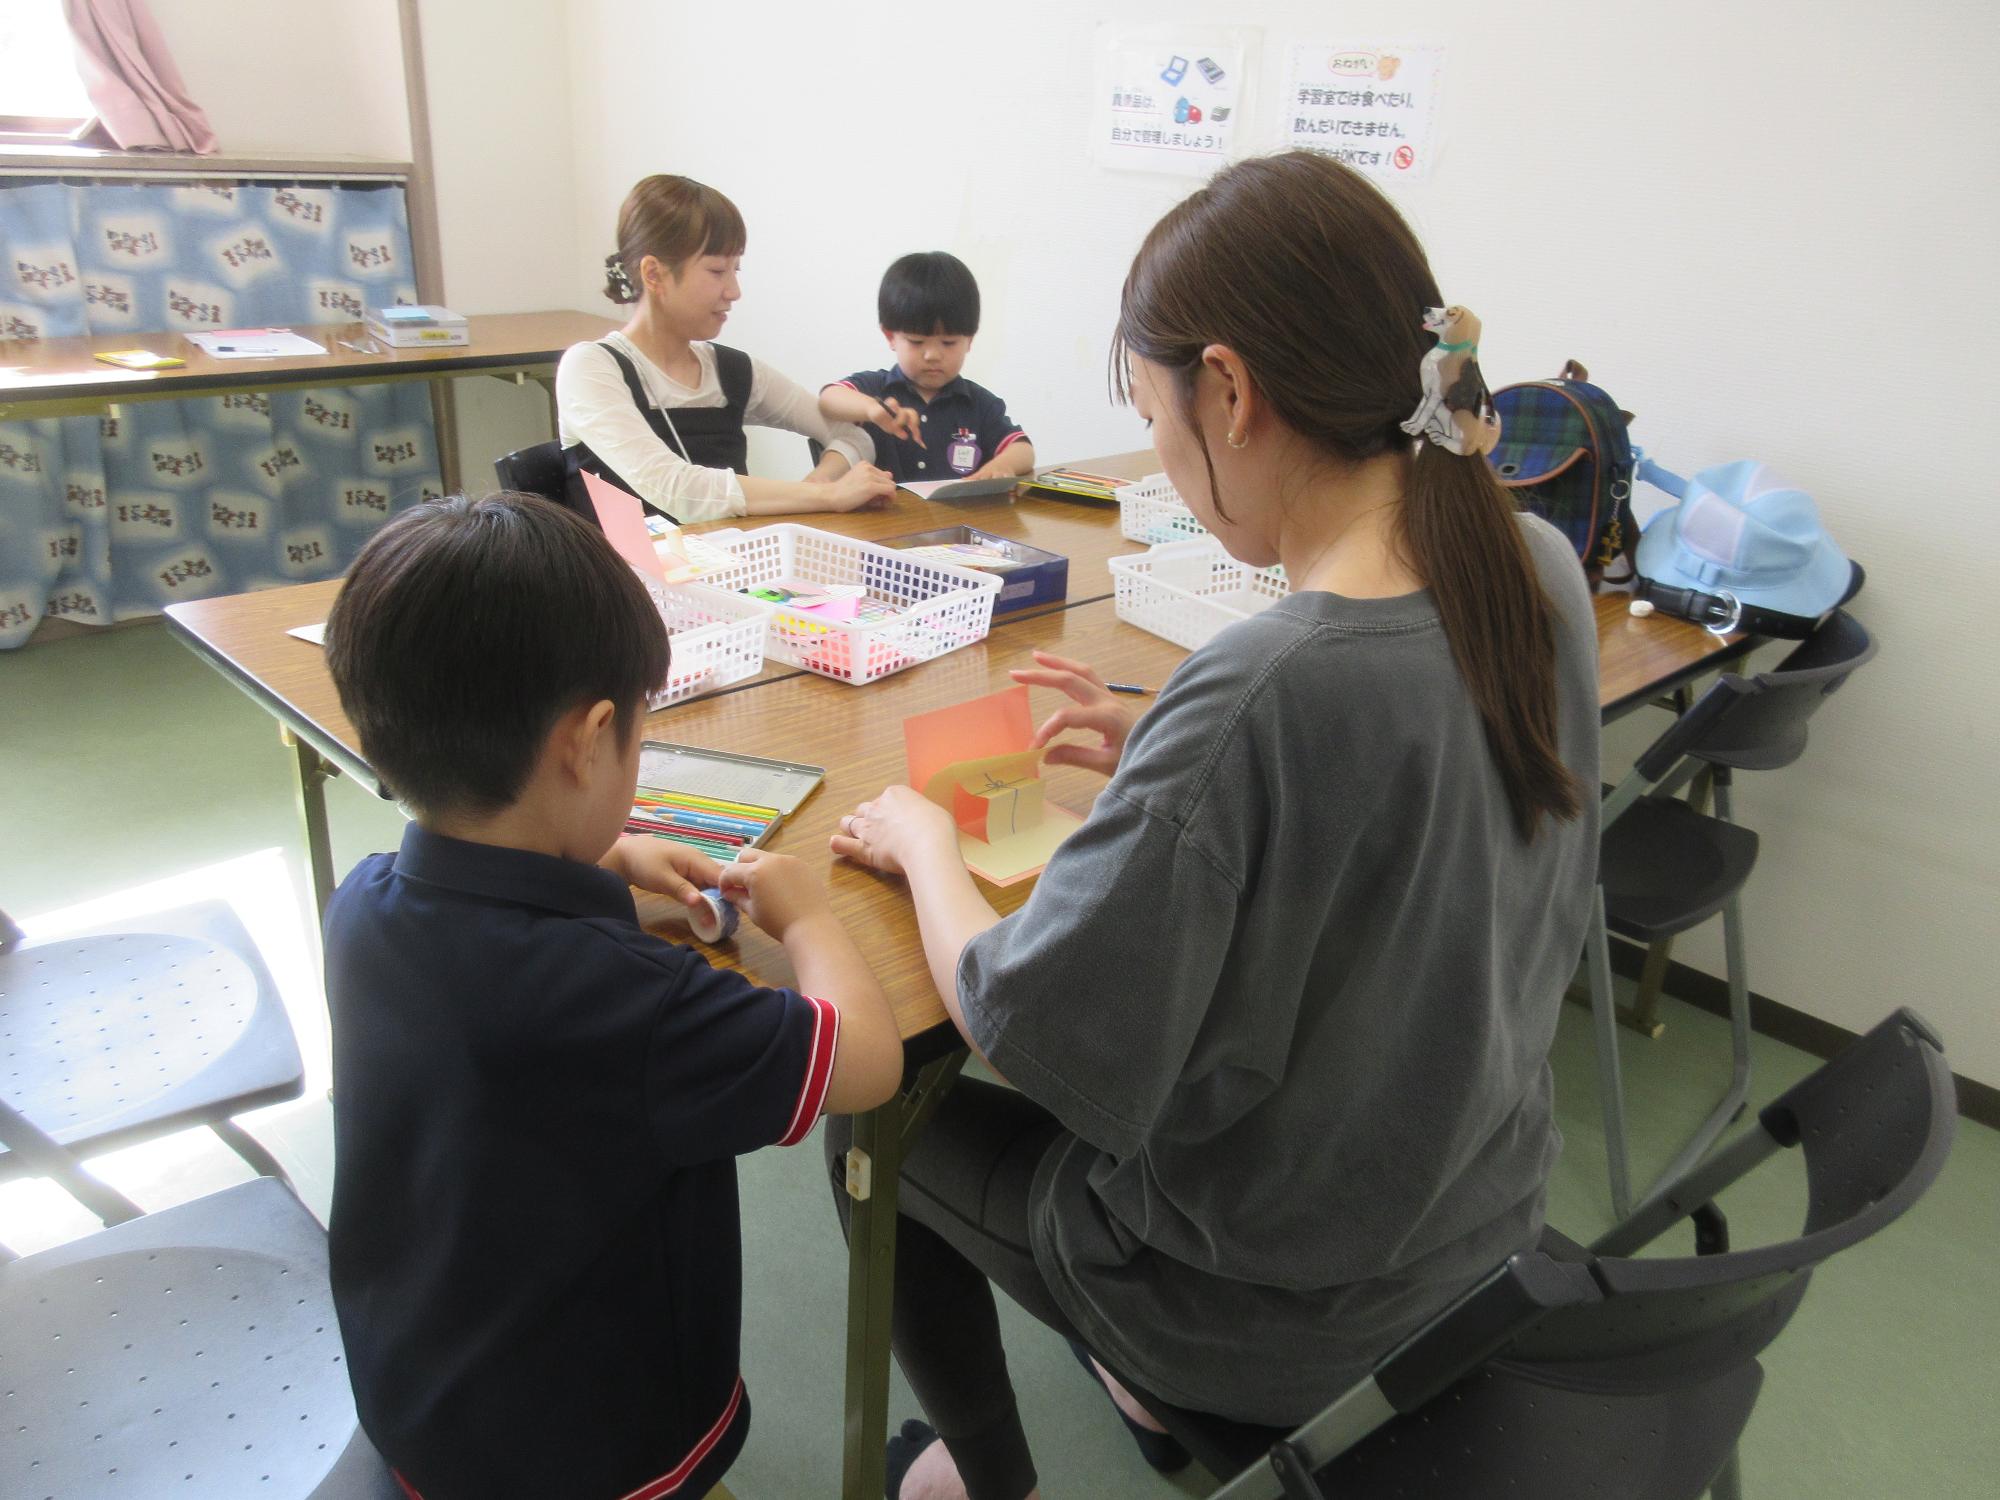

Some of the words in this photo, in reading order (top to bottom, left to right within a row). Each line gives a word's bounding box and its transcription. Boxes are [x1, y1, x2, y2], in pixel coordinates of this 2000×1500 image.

[1293, 117, 1407, 138] 飲んだりできません。
